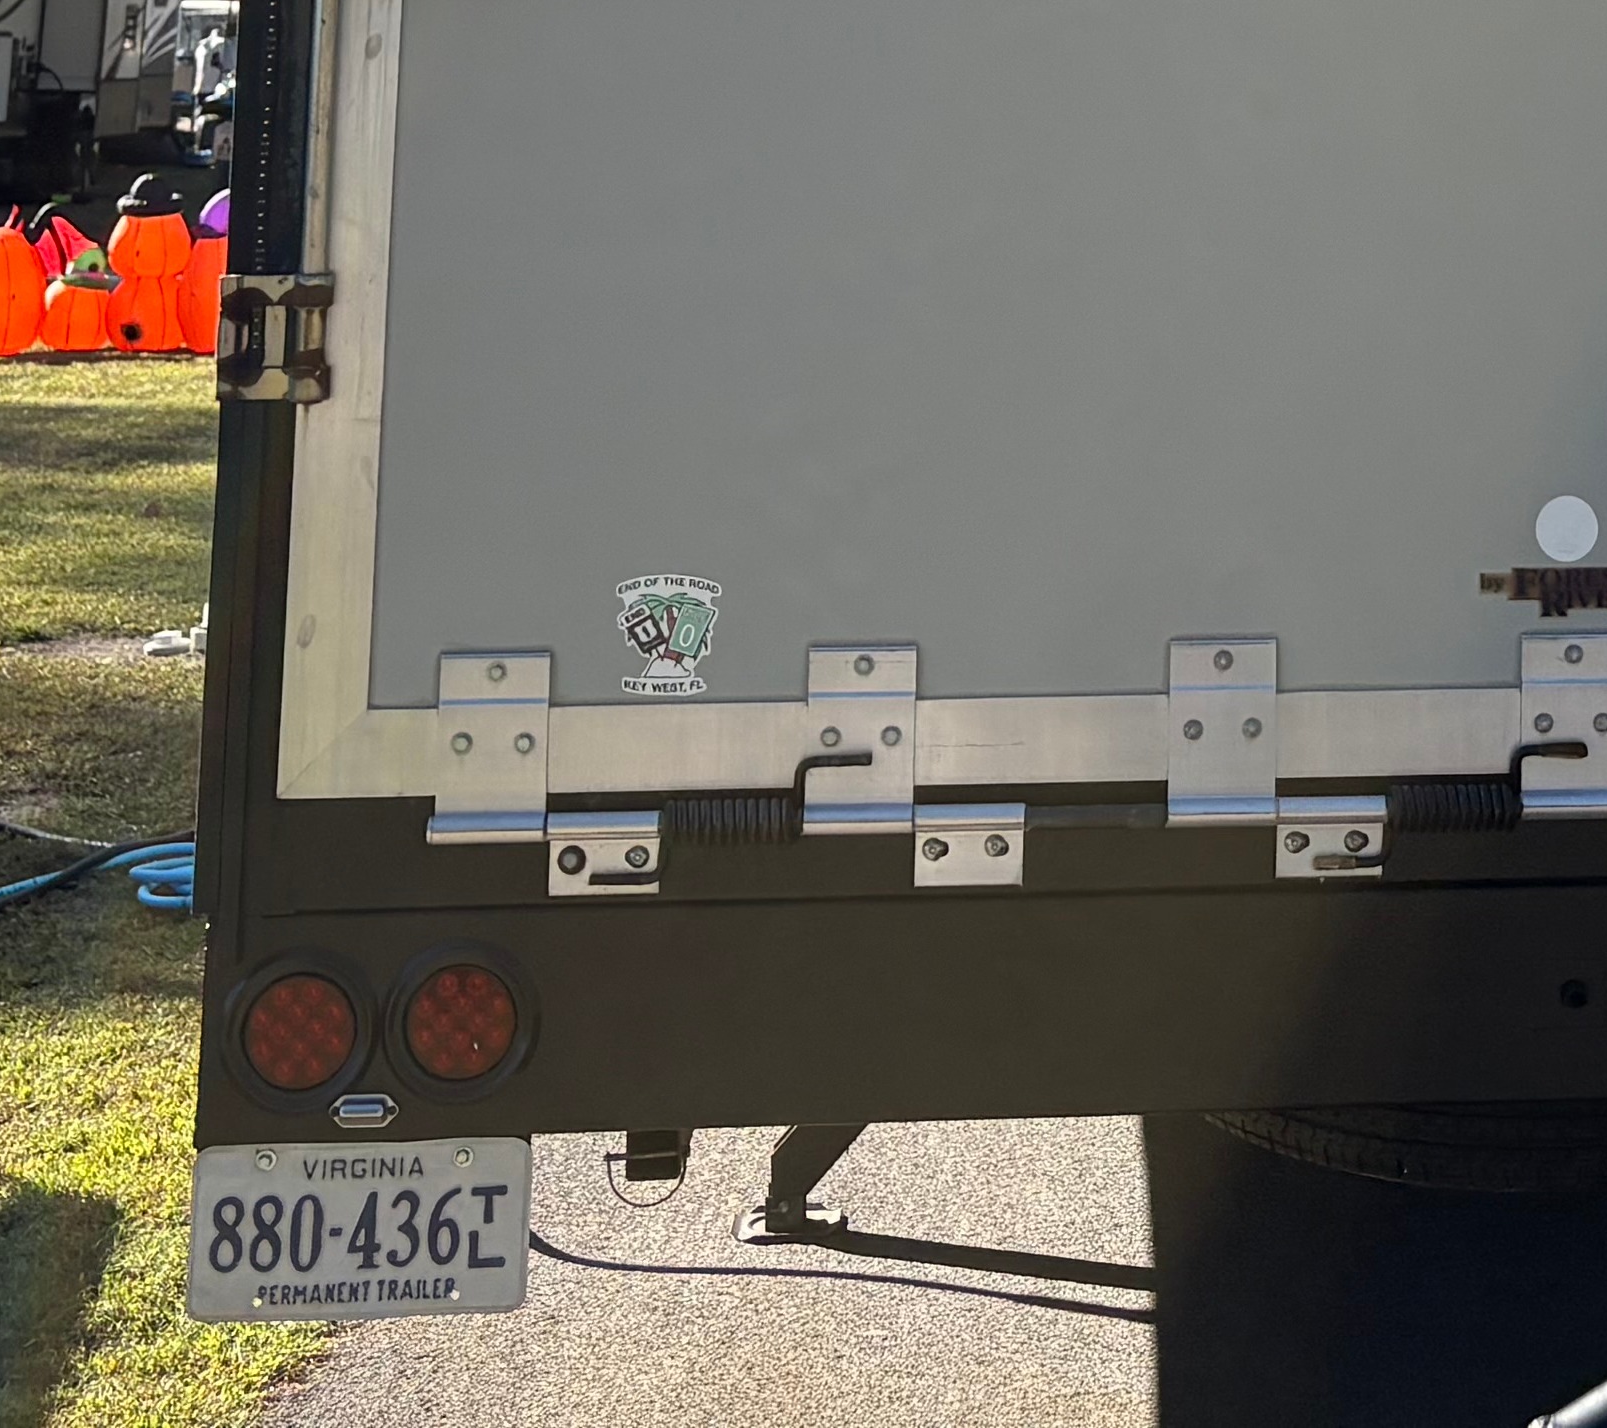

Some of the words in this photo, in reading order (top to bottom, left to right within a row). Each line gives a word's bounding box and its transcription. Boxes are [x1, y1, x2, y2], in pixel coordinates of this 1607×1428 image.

[618, 580, 641, 594] END
[644, 576, 660, 588] OF
[663, 576, 687, 586] THE
[688, 578, 720, 594] ROAD
[679, 624, 695, 648] 0
[623, 679, 647, 692] KEY
[689, 679, 704, 691] FL
[303, 1156, 425, 1180] VIRGINIA
[256, 1280, 371, 1306] PERMANENT
[377, 1277, 456, 1302] TRAILER
